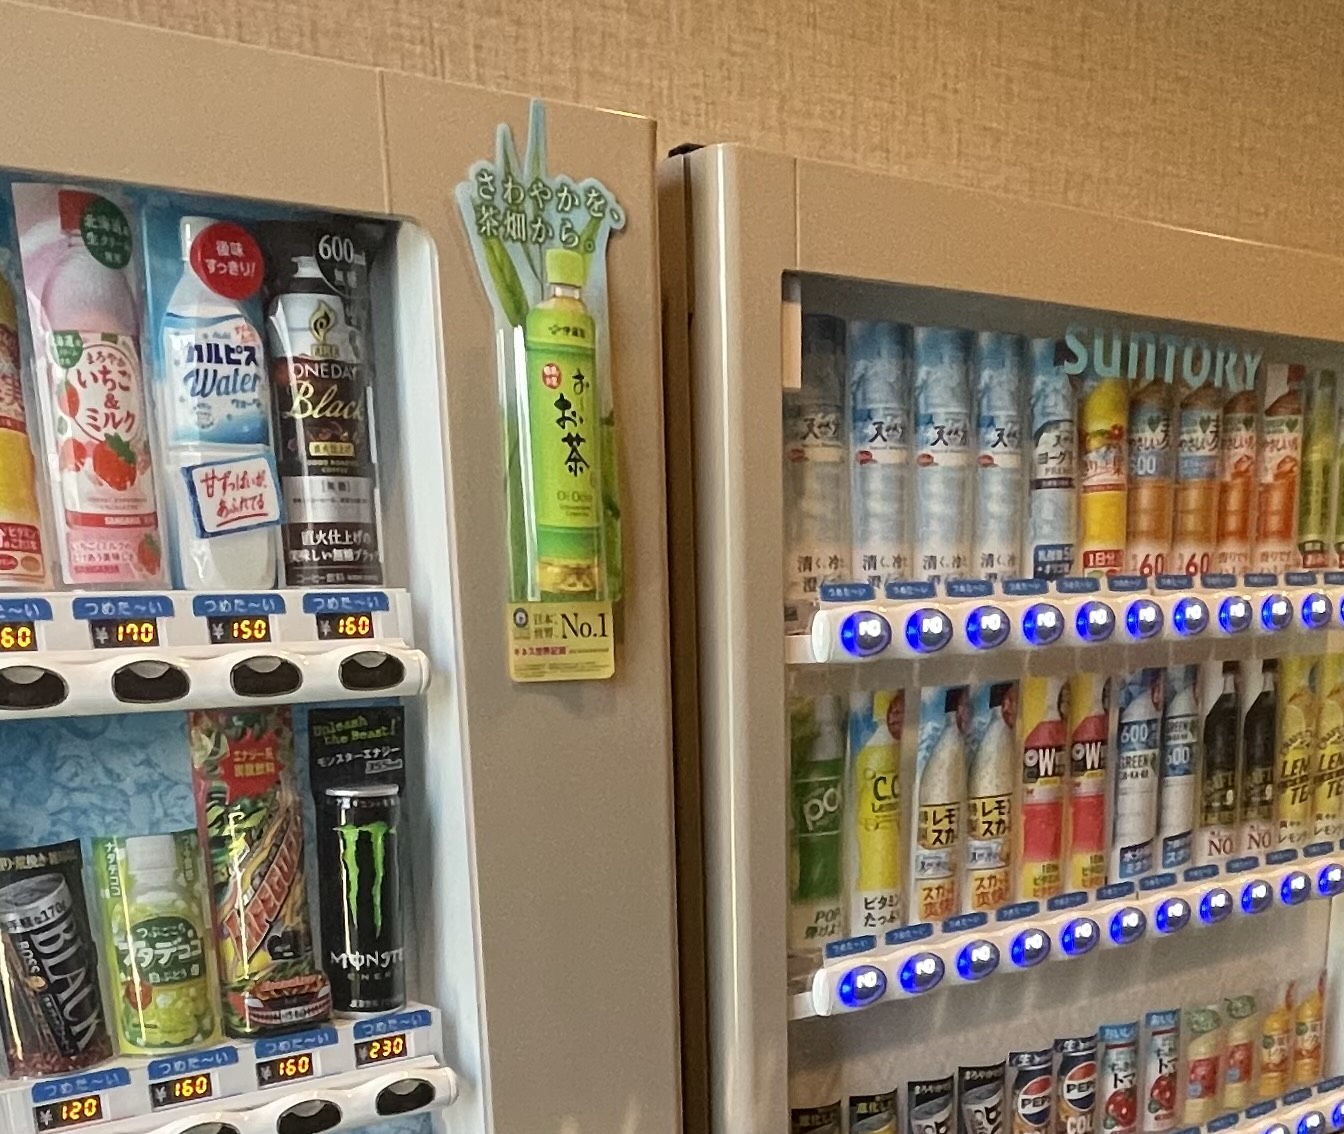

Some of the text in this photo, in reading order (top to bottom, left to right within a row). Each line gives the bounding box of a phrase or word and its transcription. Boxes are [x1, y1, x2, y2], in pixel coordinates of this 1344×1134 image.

[186, 342, 259, 365] カルピス
[76, 364, 131, 392] いちご
[183, 367, 261, 398] Water
[104, 393, 121, 411] &
[286, 380, 365, 420] Black
[86, 406, 136, 434] ミルク
[117, 623, 154, 643] 170
[233, 619, 267, 639] 150
[338, 616, 370, 635] 160
[560, 612, 609, 640] No.1
[312, 716, 370, 737] Unleash
[1120, 723, 1148, 744] 600
[316, 746, 401, 768] モンスターエナジー
[369, 1037, 403, 1058] 230
[278, 1056, 310, 1076] 160
[175, 1076, 207, 1097] 160
[63, 1098, 98, 1119] 120
